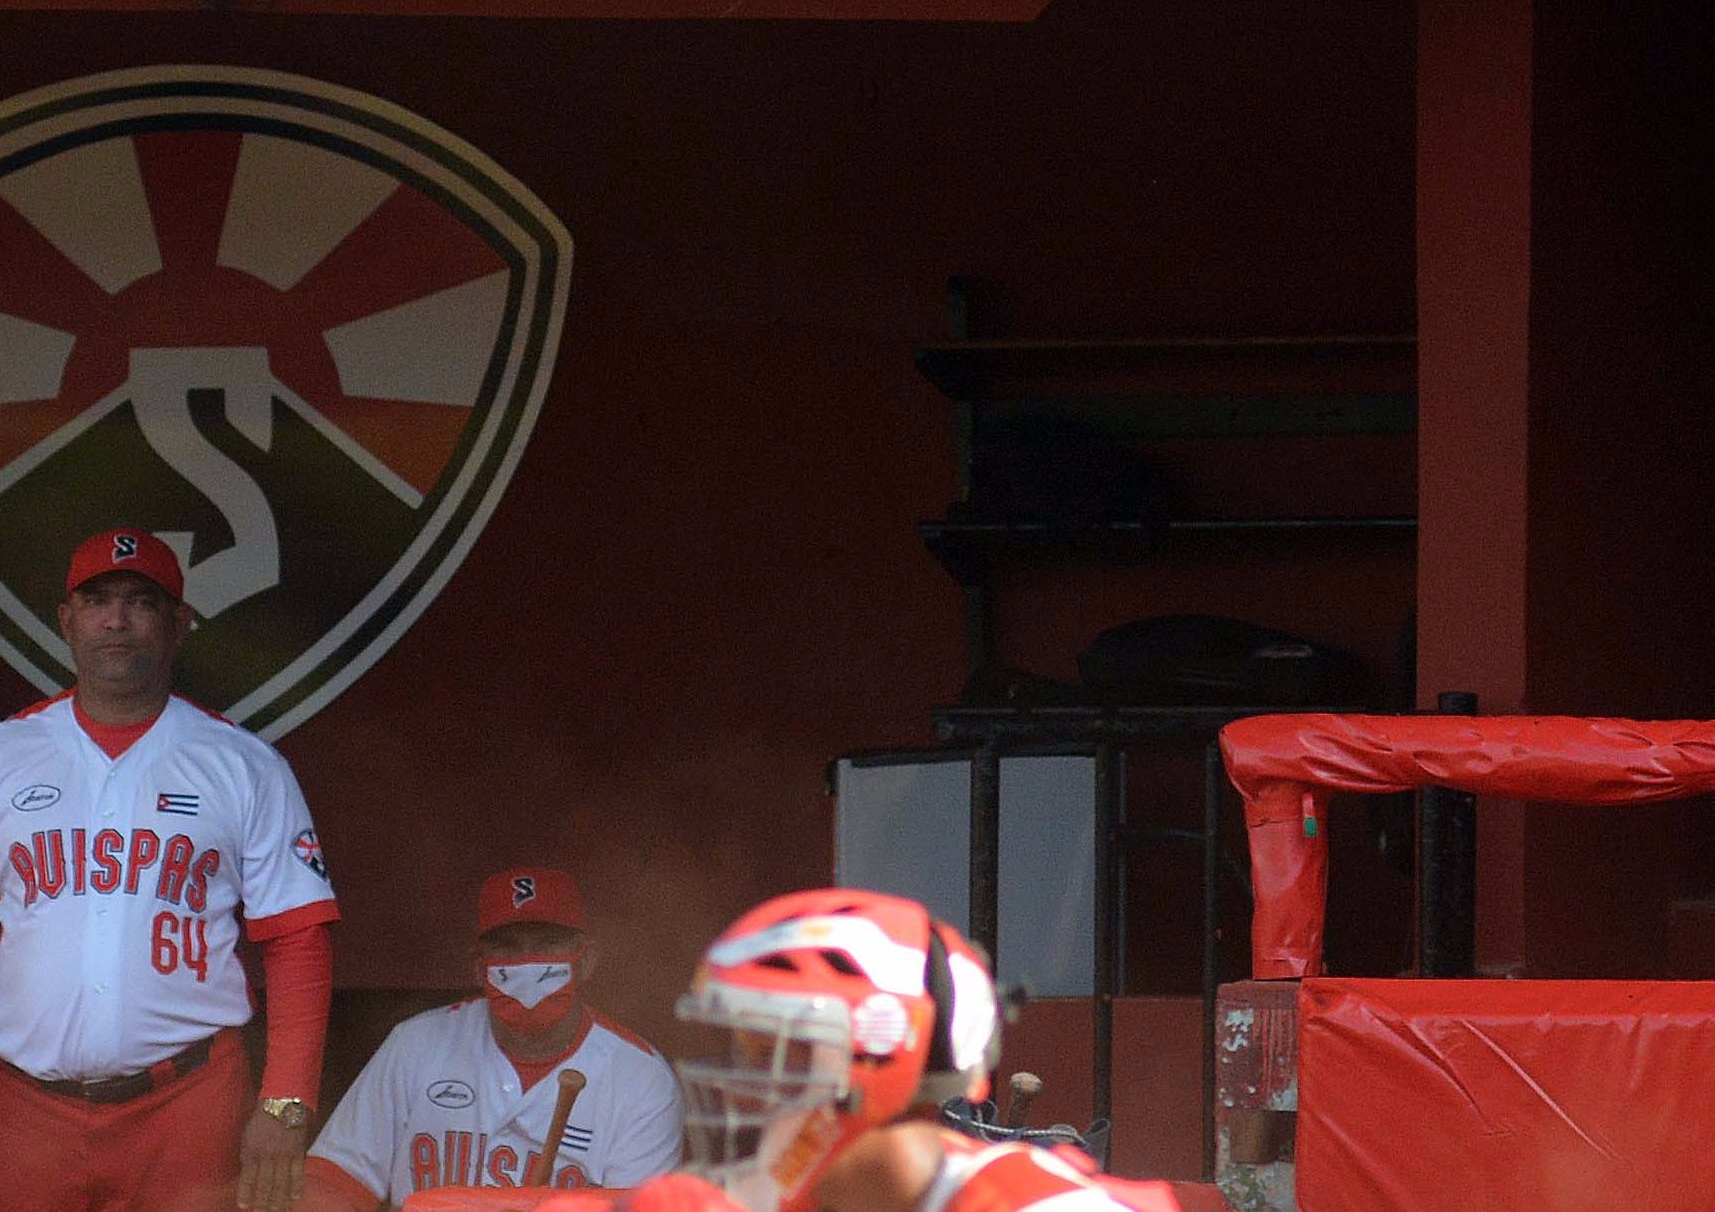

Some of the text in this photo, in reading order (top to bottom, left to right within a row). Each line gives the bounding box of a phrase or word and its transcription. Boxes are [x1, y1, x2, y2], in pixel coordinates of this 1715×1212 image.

[111, 534, 138, 563] S
[511, 875, 536, 908] S
[150, 909, 209, 984] 64
